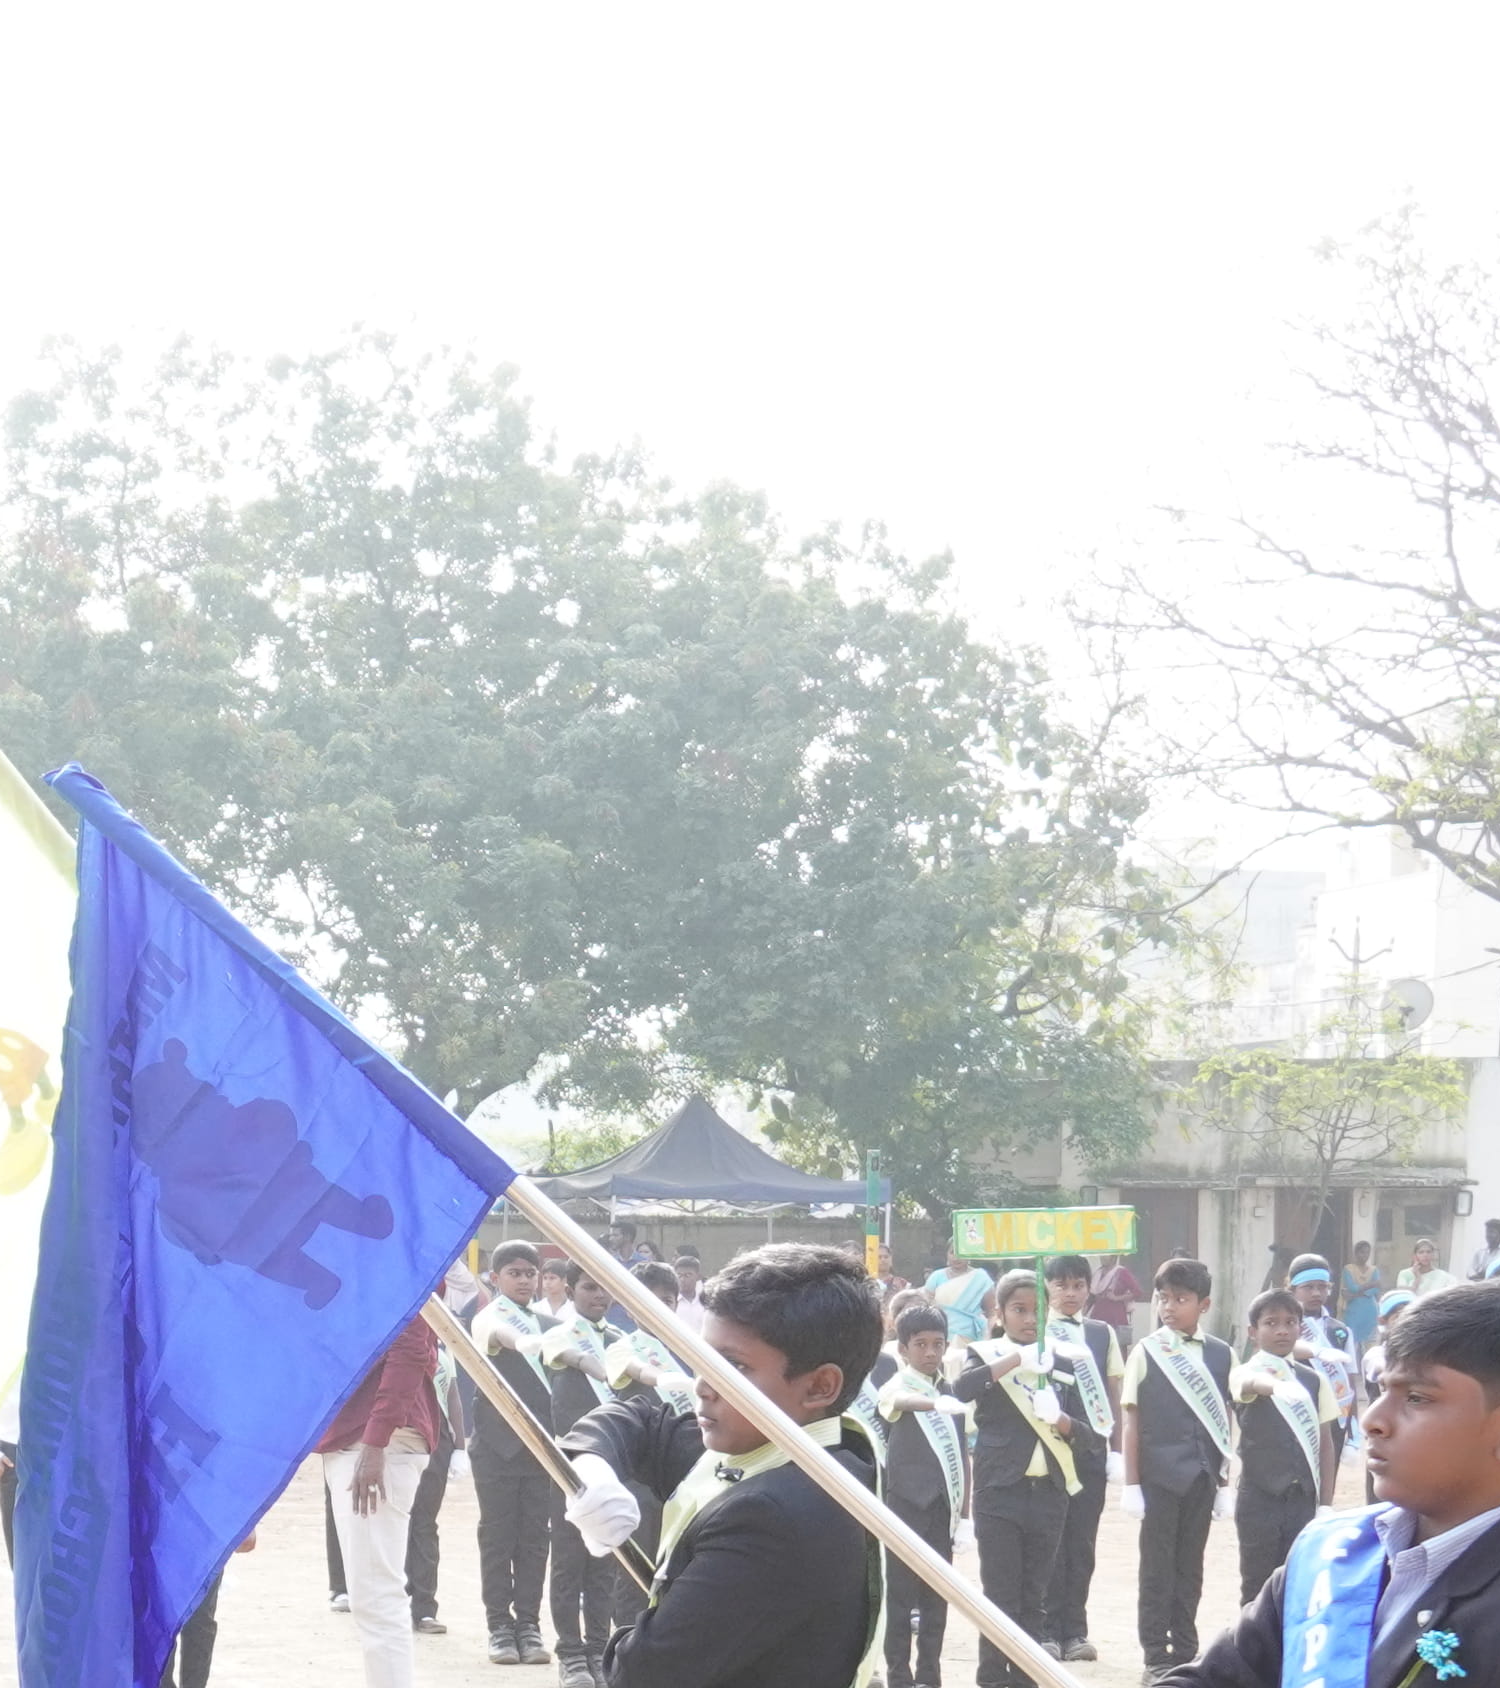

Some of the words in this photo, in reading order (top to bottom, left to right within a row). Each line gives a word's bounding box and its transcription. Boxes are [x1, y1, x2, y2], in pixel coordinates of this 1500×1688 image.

[983, 1210, 1135, 1253] MICKEY
[1168, 1354, 1206, 1396] MICKEY
[1201, 1391, 1227, 1433] HOUSE
[943, 1438, 960, 1488] HOUSE
